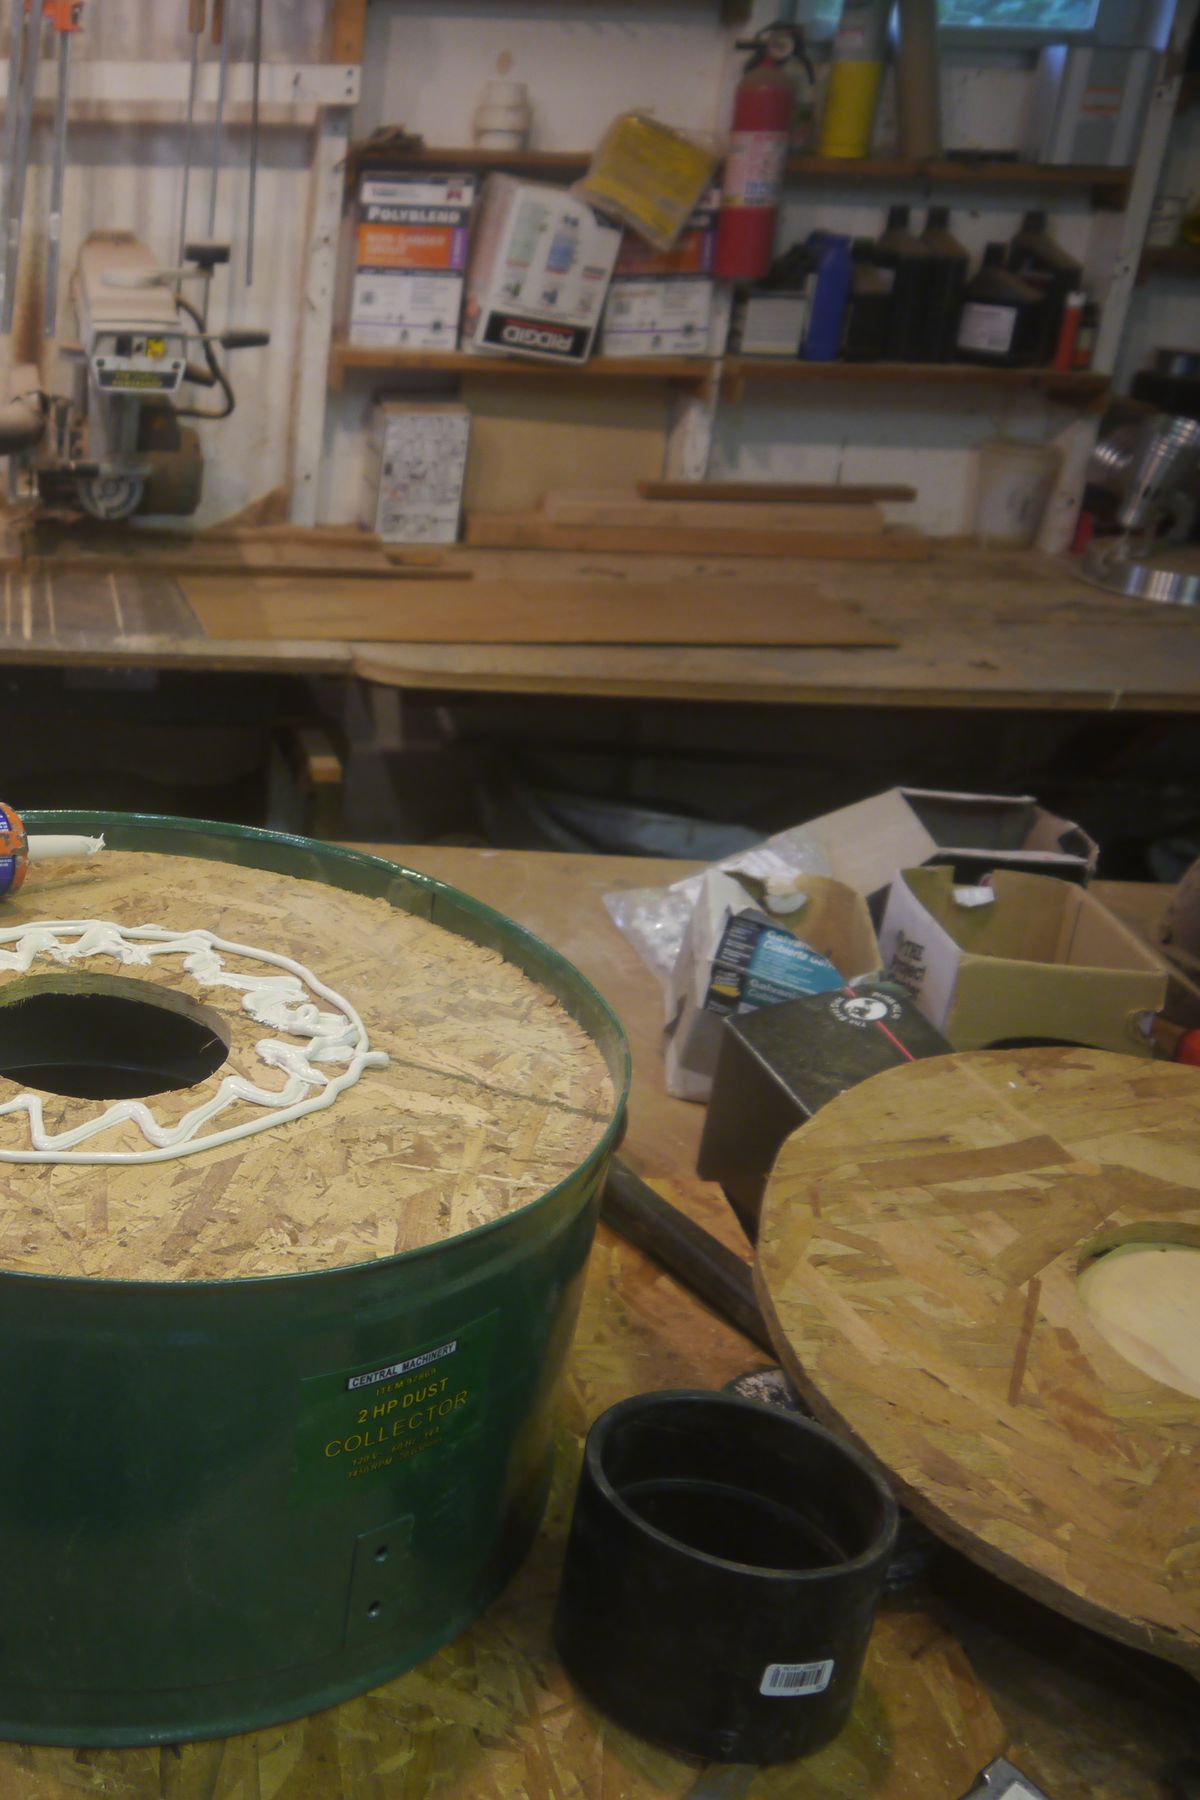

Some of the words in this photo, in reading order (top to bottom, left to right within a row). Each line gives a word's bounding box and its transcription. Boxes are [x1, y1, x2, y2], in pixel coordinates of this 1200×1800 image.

[367, 205, 460, 224] POLYBLEND
[502, 325, 574, 352] RIDGID
[352, 1367, 398, 1387] CENTRAL
[402, 1343, 455, 1372] MACHINERY
[357, 1409, 369, 1425] 2
[373, 1399, 399, 1419] HP
[402, 1377, 449, 1409] DUST
[324, 1390, 469, 1458] COLLECTOR
